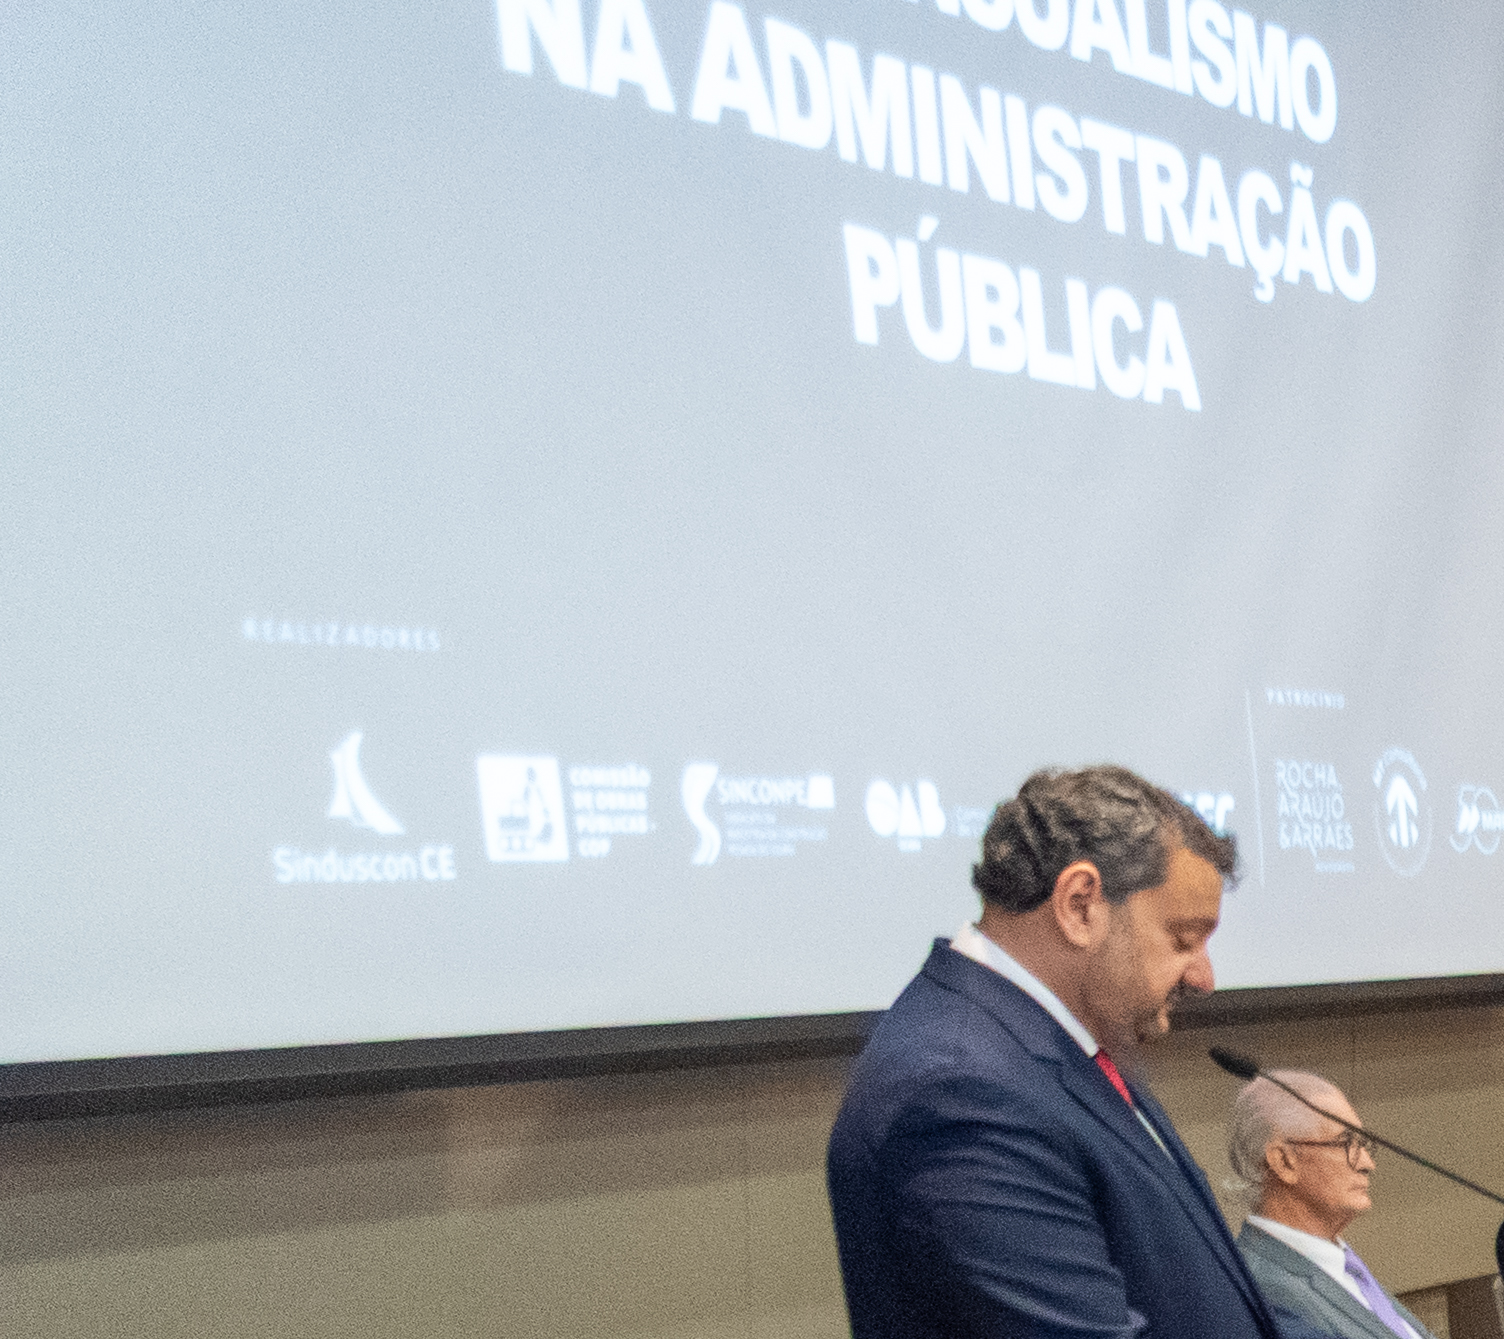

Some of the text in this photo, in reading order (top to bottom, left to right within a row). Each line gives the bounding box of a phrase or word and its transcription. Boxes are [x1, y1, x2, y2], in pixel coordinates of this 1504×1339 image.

[497, 0, 1377, 303] NA ADMINISTRAÇÃO
[842, 214, 1202, 412] PÚBLICA
[242, 618, 441, 652] REALIZADORES
[273, 845, 419, 884] Sinduscon
